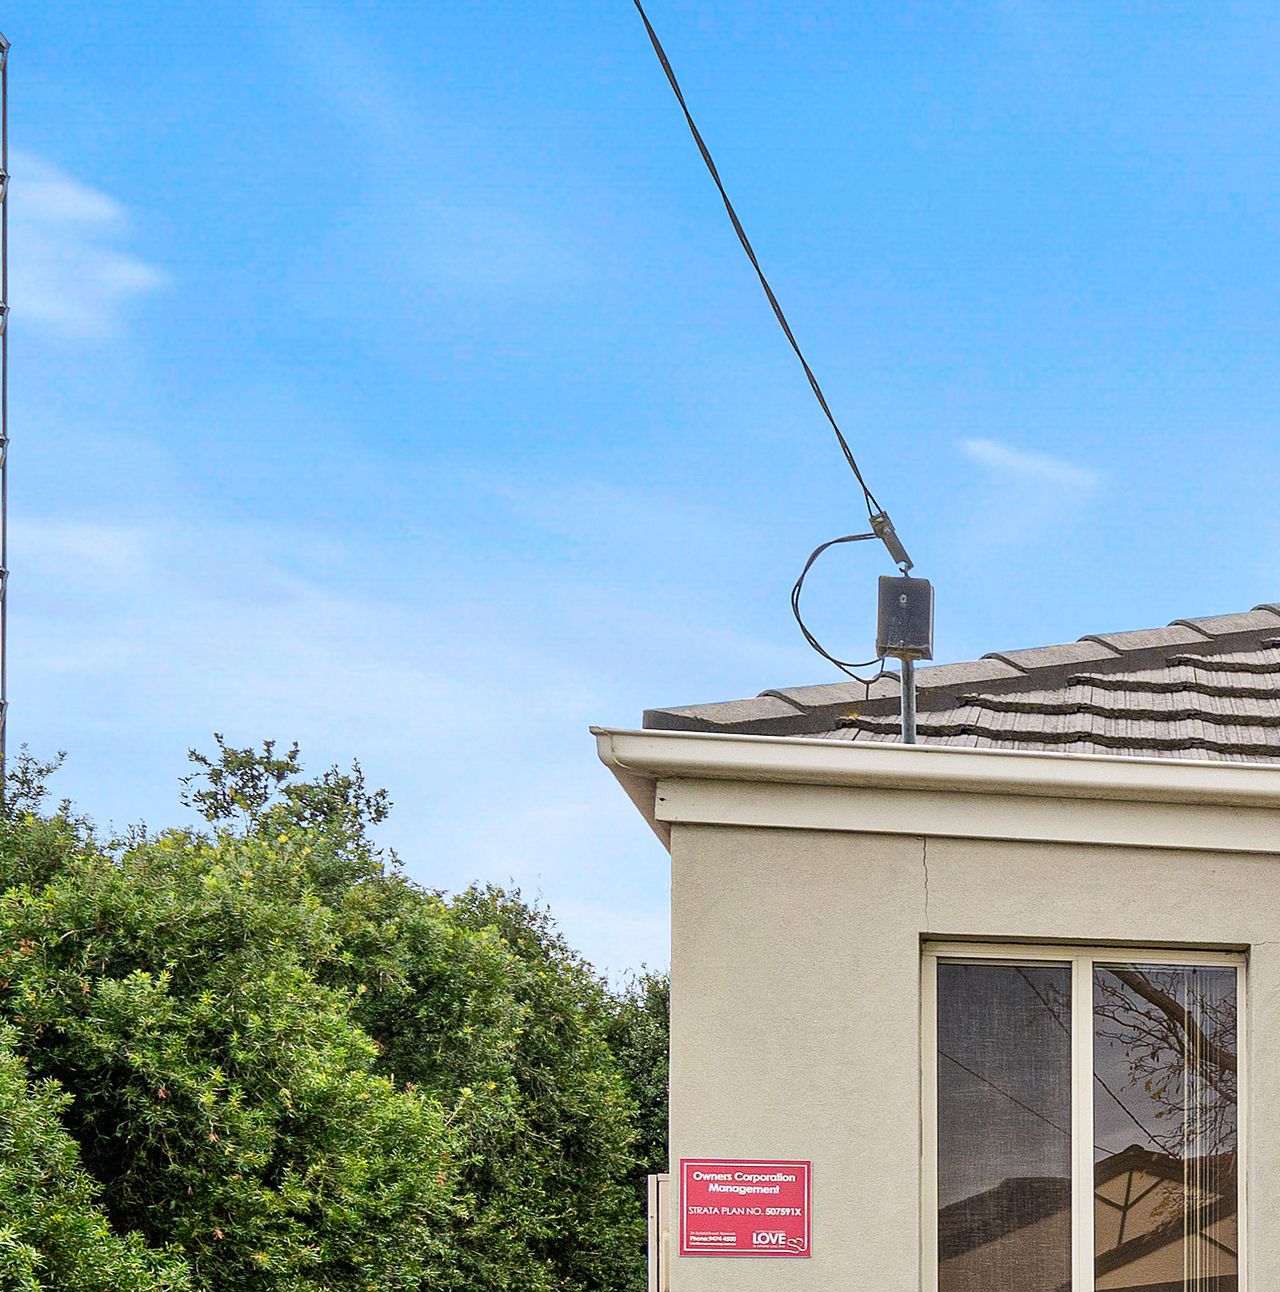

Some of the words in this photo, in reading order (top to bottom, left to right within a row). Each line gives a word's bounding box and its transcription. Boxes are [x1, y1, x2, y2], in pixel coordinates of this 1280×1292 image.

[693, 1171, 733, 1181] Owners
[734, 1172, 796, 1183] Corporation
[708, 1183, 780, 1195] Management
[688, 1206, 720, 1215] STRATA
[721, 1207, 745, 1215] PLAN
[747, 1207, 764, 1215] NO.
[765, 1208, 802, 1216] 507591X
[752, 1232, 787, 1245] LOVE
